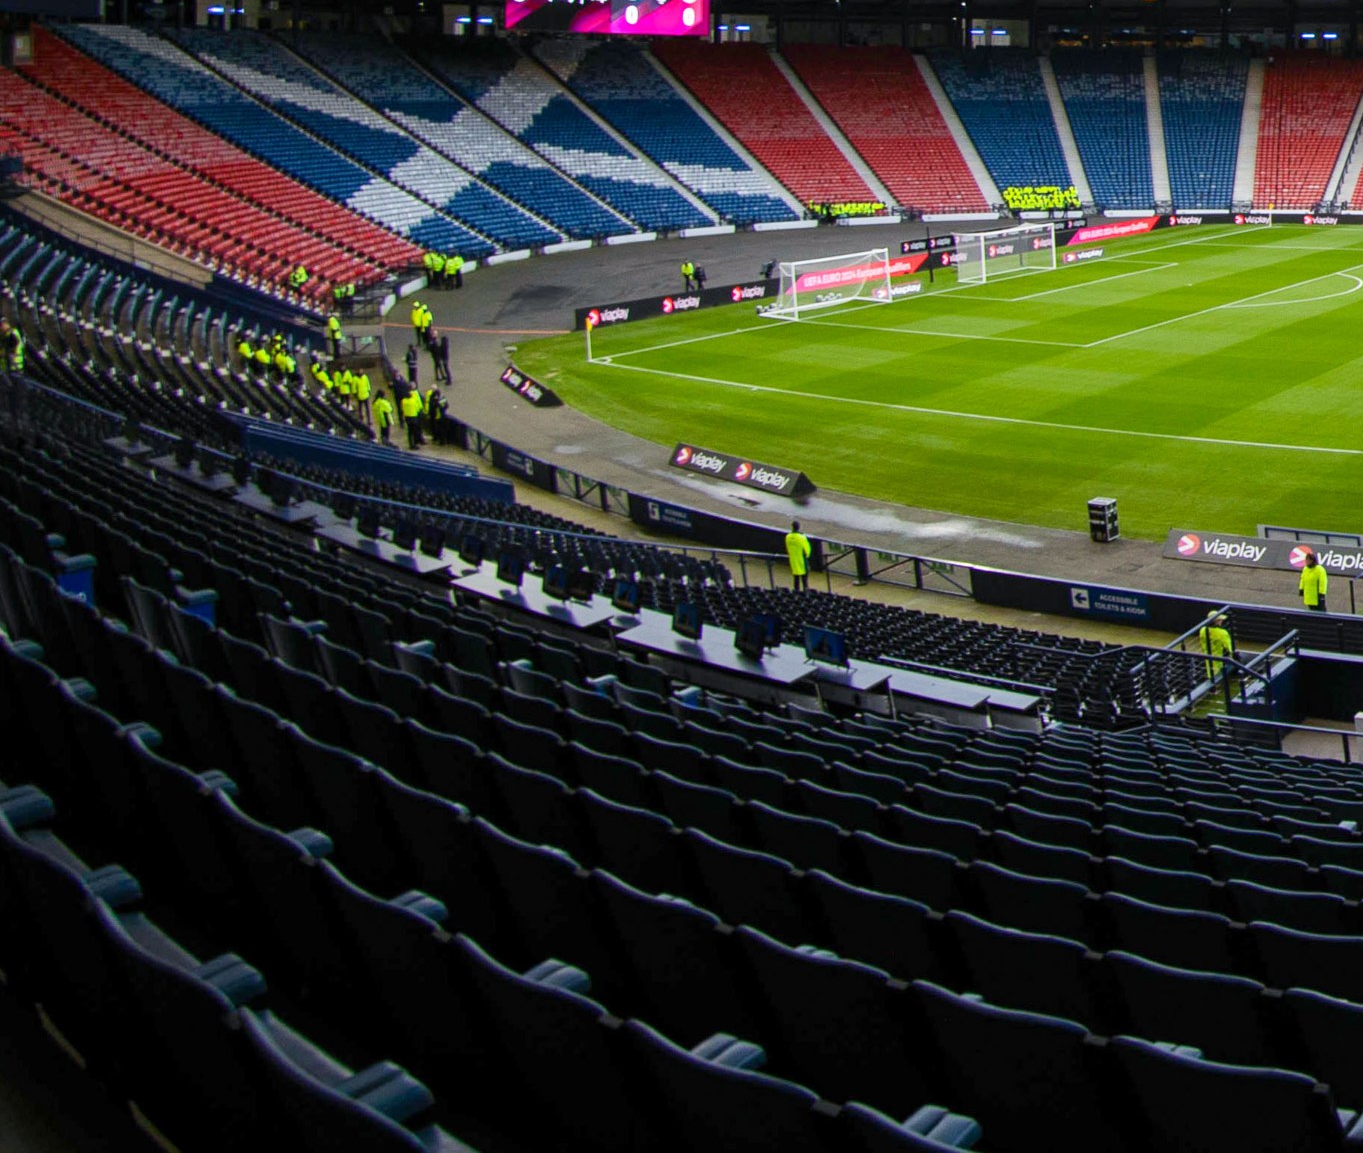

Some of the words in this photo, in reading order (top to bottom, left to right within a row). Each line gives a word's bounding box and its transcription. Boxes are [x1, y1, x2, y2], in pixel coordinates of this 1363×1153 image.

[625, 5, 639, 24] 0
[682, 7, 695, 26] 0
[1176, 216, 1202, 225] viaplay
[1312, 216, 1338, 226] viaplay
[600, 308, 630, 323] viaplay
[690, 452, 727, 473] viaplay
[751, 468, 790, 489] viaplay
[1203, 538, 1267, 562] viaplay
[1100, 594, 1138, 605] ACCESSIBLE
[1094, 602, 1119, 612] TOILETS
[1126, 607, 1146, 615] KIOSK
